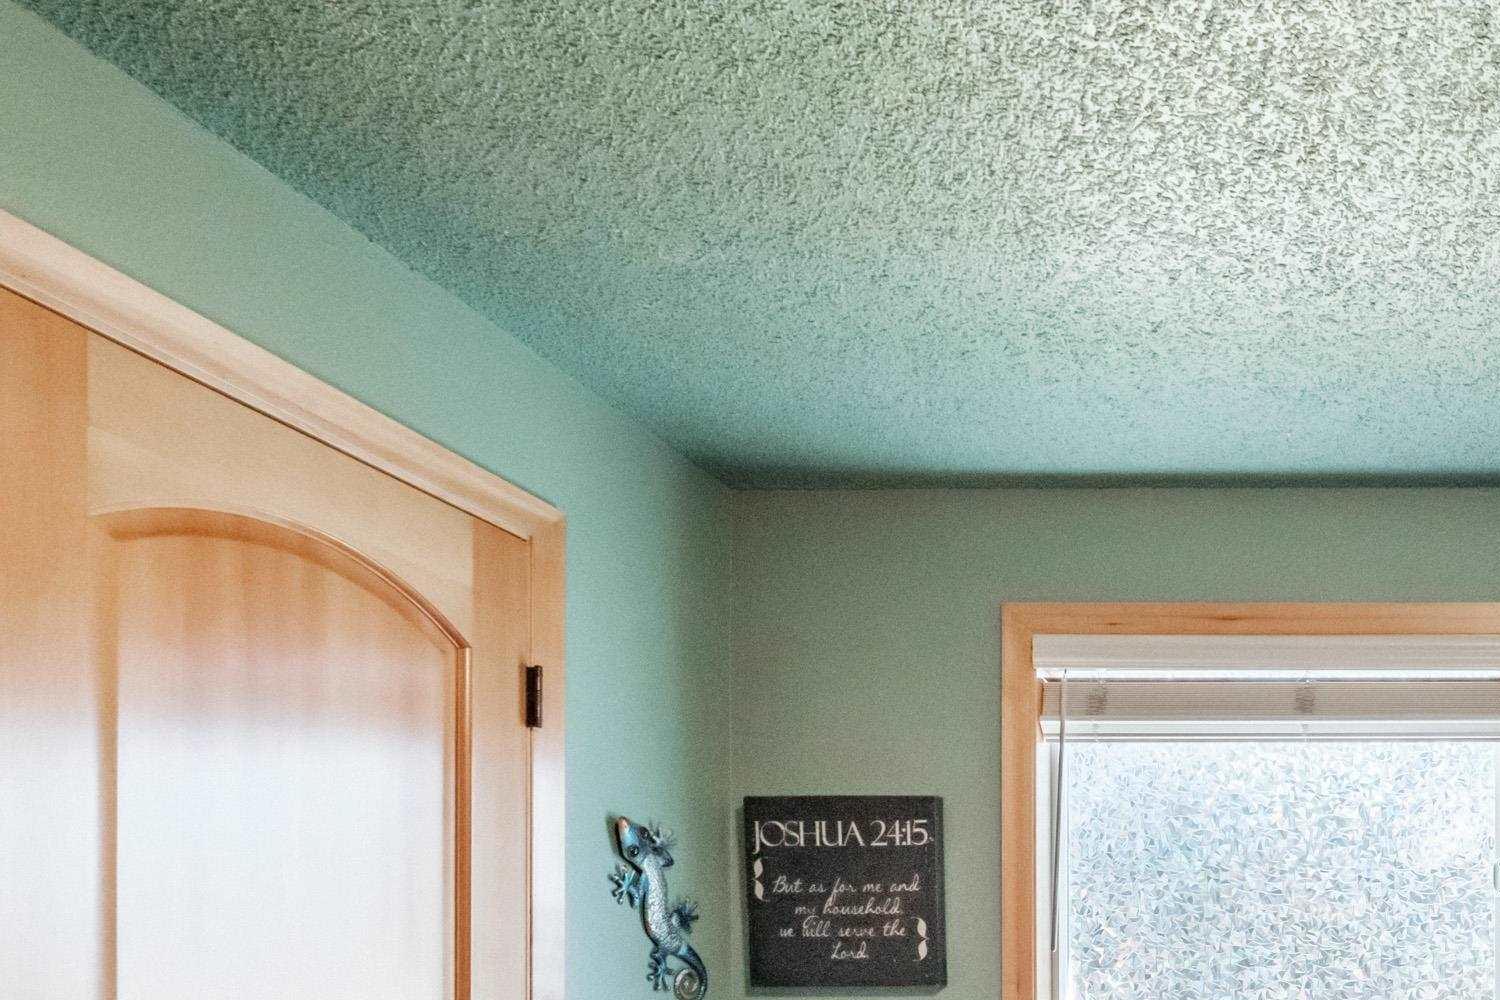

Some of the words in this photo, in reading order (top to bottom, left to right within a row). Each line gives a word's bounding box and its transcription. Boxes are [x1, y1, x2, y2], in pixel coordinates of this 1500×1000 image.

[753, 819, 866, 854] JOSHUA
[870, 819, 929, 847] 24:15
[772, 875, 804, 893] But
[809, 882, 827, 892] as
[832, 877, 857, 898] for
[863, 883, 882, 891] me
[889, 873, 921, 892] and
[822, 896, 902, 915] household
[779, 927, 795, 938] we
[838, 926, 876, 937] serve
[883, 919, 907, 937] the
